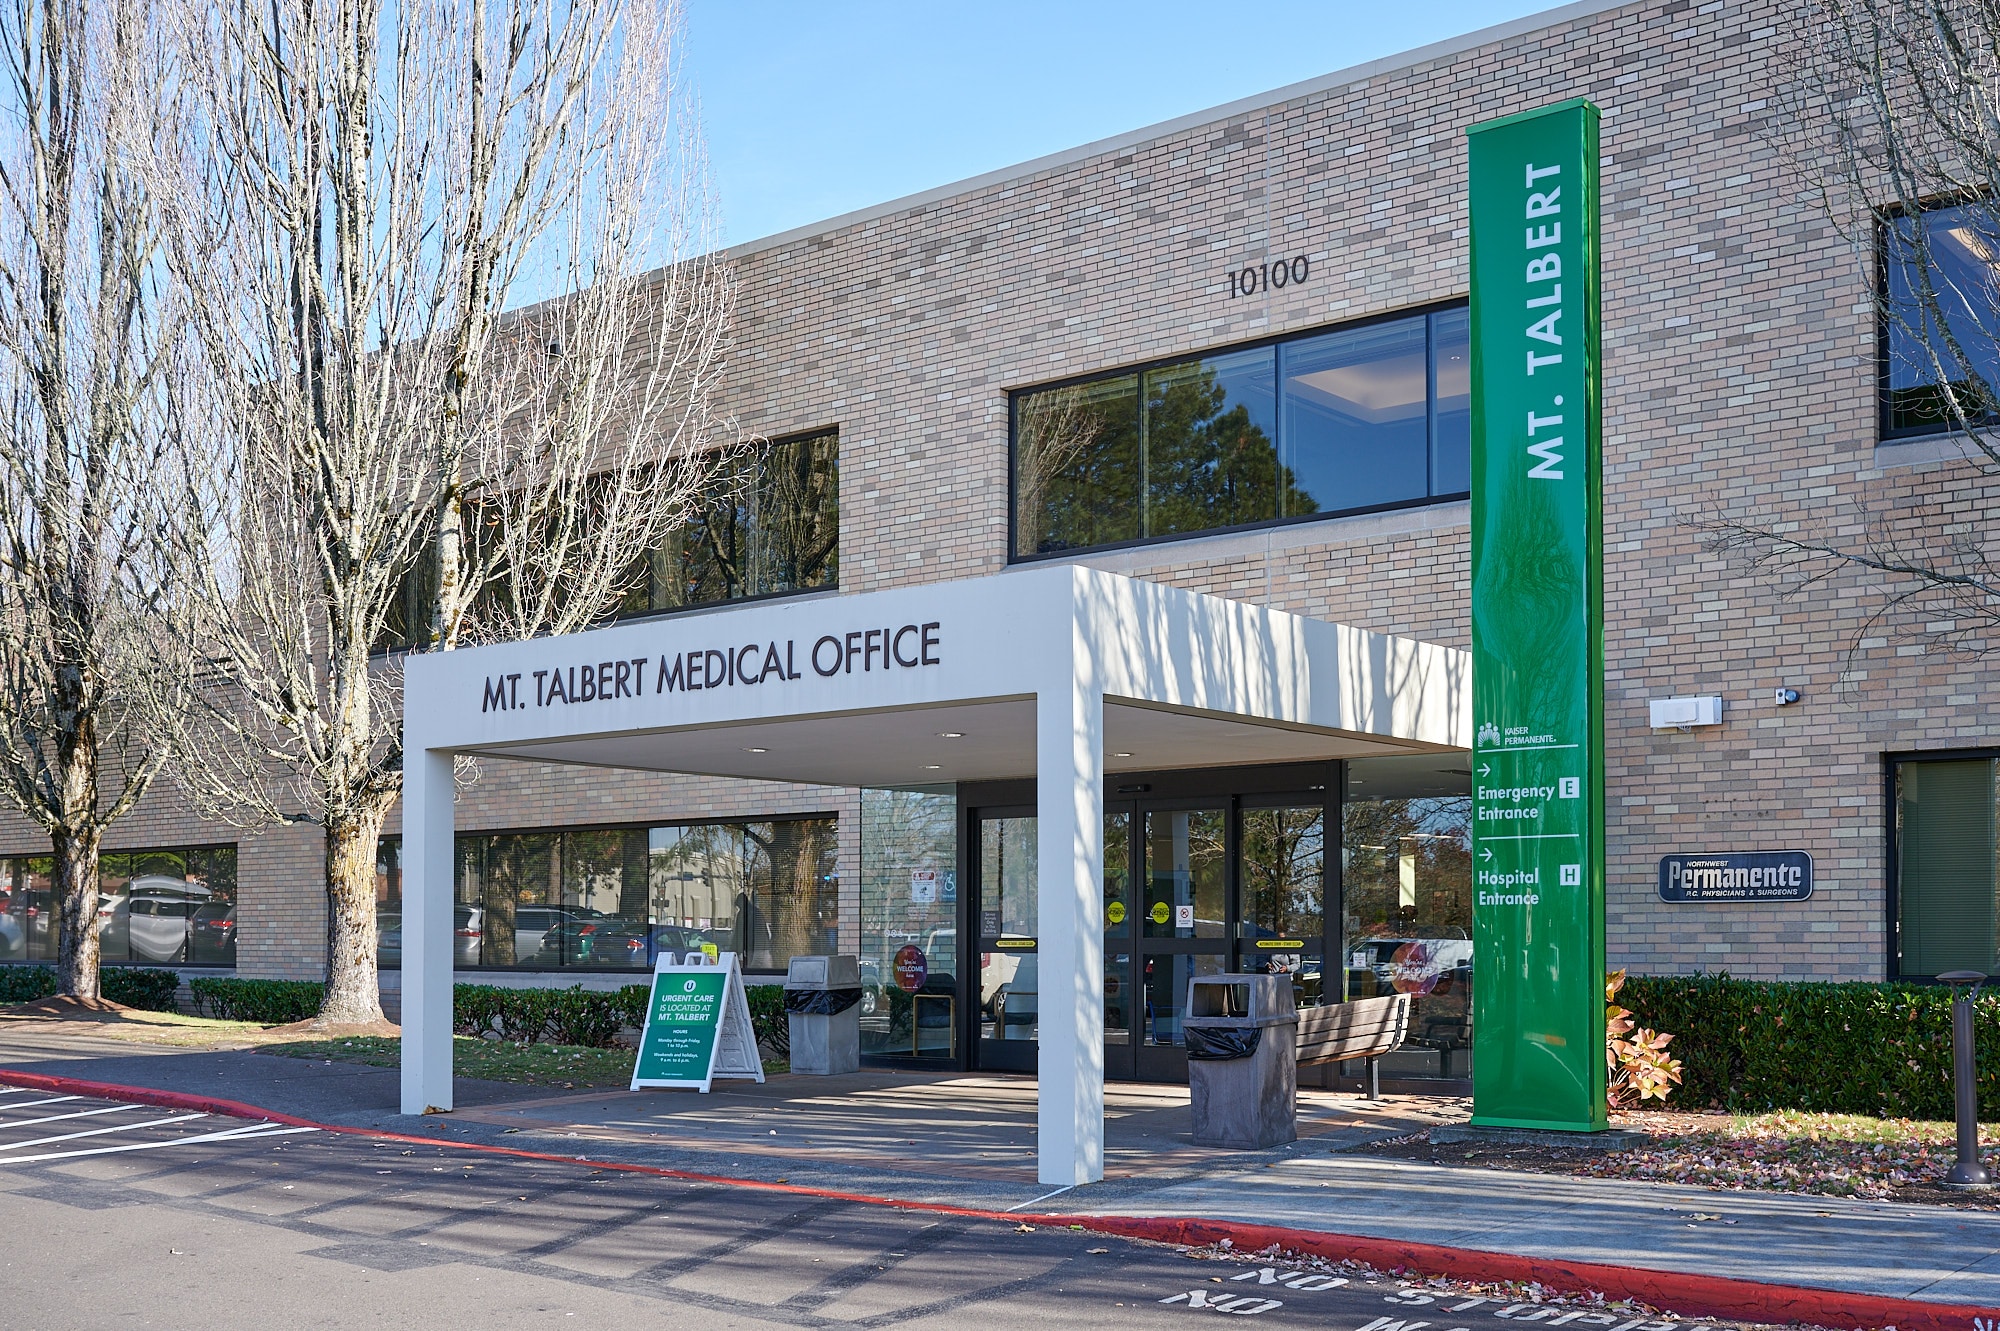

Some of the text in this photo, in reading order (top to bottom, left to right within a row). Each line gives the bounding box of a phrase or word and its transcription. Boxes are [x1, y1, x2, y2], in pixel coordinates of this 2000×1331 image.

[1228, 255, 1308, 299] 10100
[1526, 163, 1563, 480] MT. TALBERT
[481, 621, 940, 713] MT. TALBERT MEDICAL OFFICE
[1505, 727, 1529, 736] KAISER
[1478, 785, 1556, 803] Emergency
[1565, 781, 1573, 795] E
[1478, 806, 1538, 821] Entrance
[1687, 860, 1729, 868] NORTHWEST
[1478, 867, 1539, 888] Hospital
[1564, 868, 1576, 883] H
[1668, 861, 1802, 889] Permanente
[1479, 891, 1539, 906] Entrance
[1702, 889, 1746, 897] PHYSICIANS
[1757, 888, 1798, 896] SURGEONS
[1395, 966, 1433, 974] WELCOME
[701, 1004, 712, 1012] AT
[675, 1013, 711, 1021] TALBERT
[1229, 1267, 1349, 1291] NO
[1158, 1289, 1284, 1315] NO
